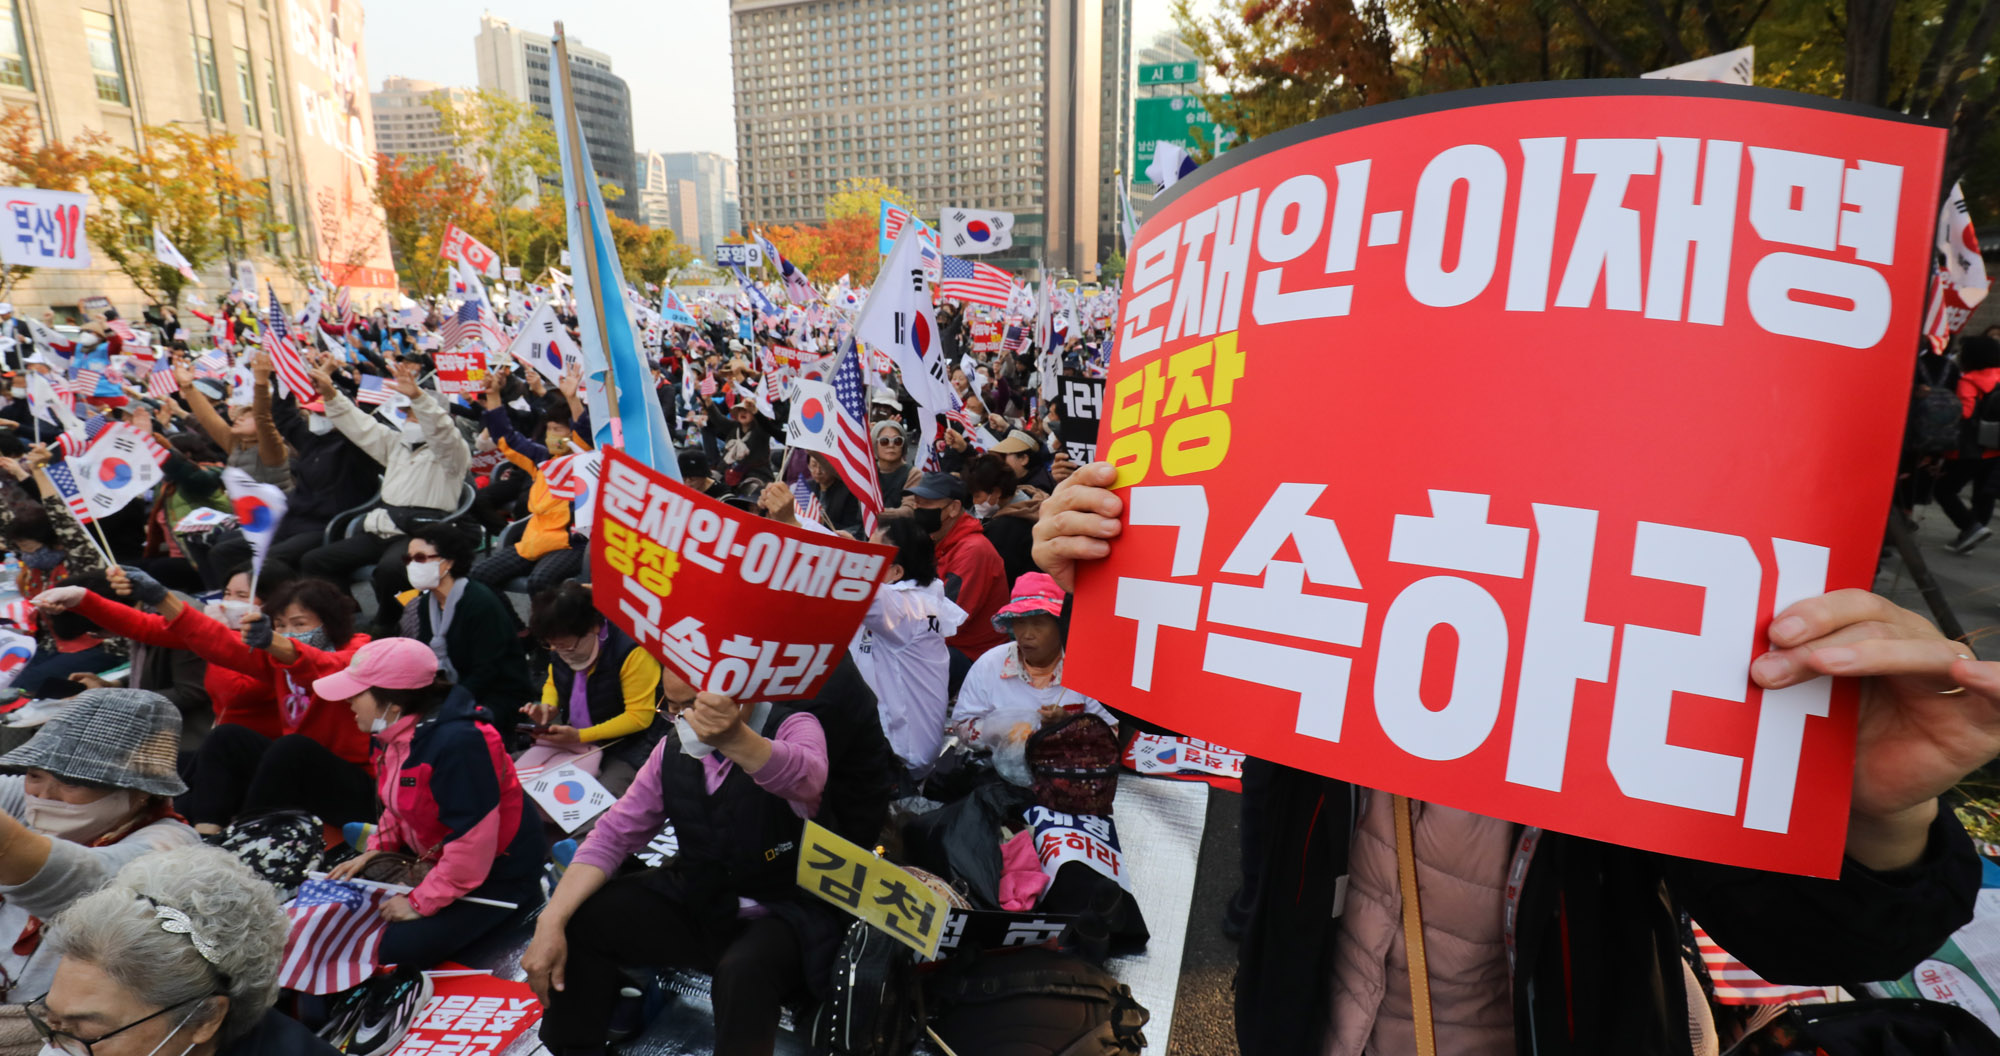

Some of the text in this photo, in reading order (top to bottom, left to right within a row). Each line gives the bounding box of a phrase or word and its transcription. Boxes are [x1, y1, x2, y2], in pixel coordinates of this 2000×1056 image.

[748, 248, 758, 262] 9
[1119, 135, 1903, 364] 문재인·이재명
[1108, 331, 1247, 489] 당장
[602, 459, 886, 602] 문재인·이재명
[603, 518, 681, 598] 당장
[619, 575, 835, 700] 구속하라
[1114, 482, 1832, 835] 구속하라
[806, 842, 936, 949] 김천
